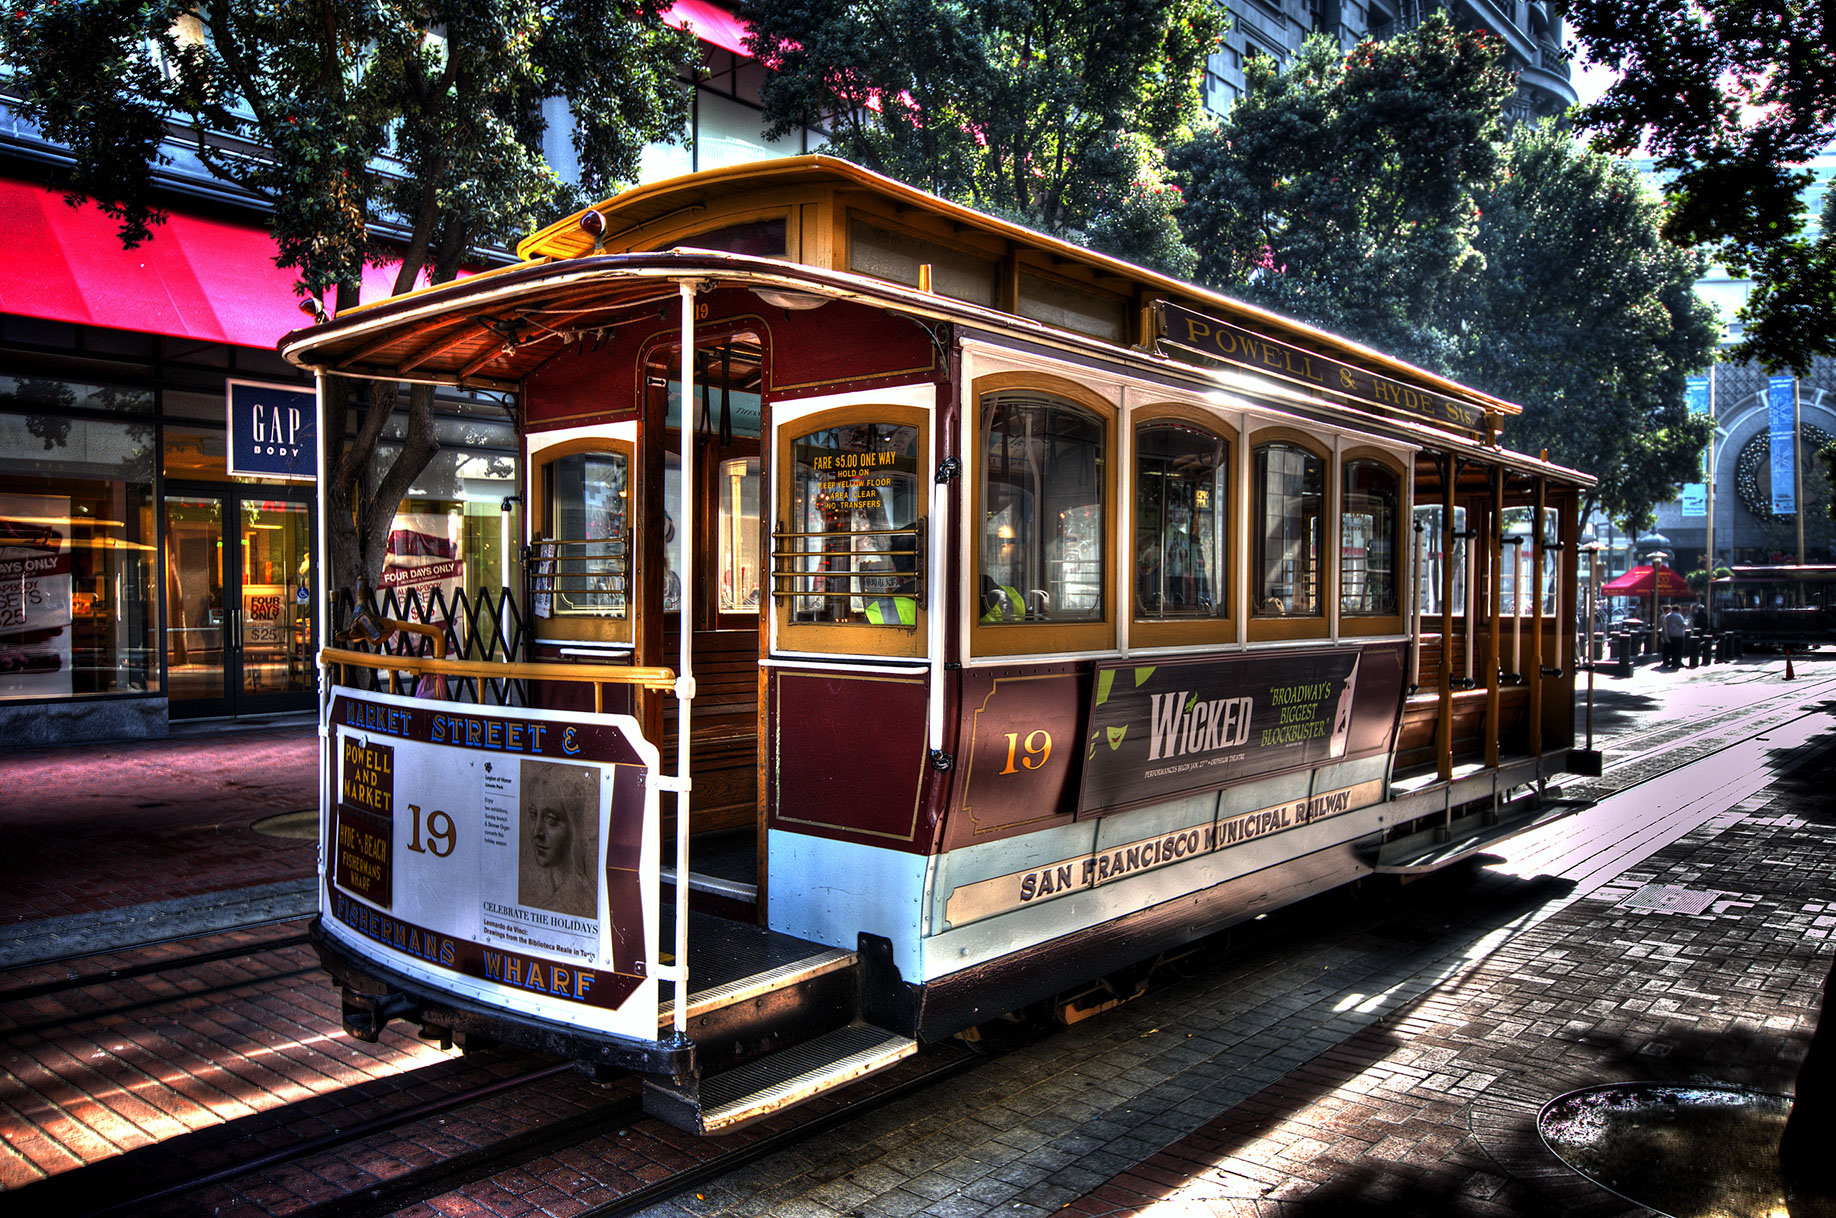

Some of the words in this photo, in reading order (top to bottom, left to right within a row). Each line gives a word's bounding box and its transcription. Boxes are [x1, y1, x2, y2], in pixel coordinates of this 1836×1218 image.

[695, 303, 709, 320] 19
[1185, 317, 1323, 382] POWELL
[1339, 367, 1358, 390] &
[1373, 378, 1435, 414] HYDE
[1446, 402, 1476, 426] Sts.
[252, 403, 301, 445] GAP
[253, 445, 299, 457] BODY
[813, 456, 833, 470] FARE
[835, 453, 858, 468] $5.00
[860, 452, 876, 467] ONE
[878, 451, 896, 465] WAY
[837, 469, 857, 478] HOLD
[859, 468, 870, 476] ON
[818, 481, 836, 489] KEEP
[837, 480, 865, 489] YELLOW
[866, 478, 892, 487] FLOOR
[830, 491, 849, 499] AREA
[852, 490, 876, 498] CLEAR
[840, 500, 881, 509] TRANSFERS
[25, 557, 58, 571] ONLY
[384, 571, 409, 583] FOUR
[410, 567, 432, 578] DAYS
[433, 563, 455, 574] ONLY
[0, 608, 28, 627] 25
[251, 603, 281, 612] DAYS
[251, 611, 279, 620] ONLY
[251, 629, 277, 641] $25
[1280, 702, 1319, 724] BIGGEST
[346, 700, 412, 736] MARKET
[431, 714, 547, 752] STREET
[562, 726, 581, 755] &
[345, 743, 391, 774] POWELL
[998, 729, 1053, 776] 19
[355, 768, 378, 786] AND
[1144, 765, 1178, 779] PERFORMANCES
[344, 778, 392, 811] MARKET
[407, 803, 457, 858] 19
[340, 823, 355, 850] HYDE
[364, 833, 387, 863] BEACH
[1020, 863, 1072, 902] SAN
[1081, 829, 1199, 886] FRANCISCO
[1204, 811, 1290, 852] MUNICIPAL
[1295, 790, 1352, 823] RAILWAY
[342, 851, 381, 882] FISHERMANS
[350, 870, 371, 892] WHARF
[483, 901, 530, 921] CELEBRATE
[530, 911, 549, 925] THE
[550, 916, 599, 935] HOLIDAYS
[483, 918, 506, 930] Leonardo
[506, 923, 513, 932] da
[513, 925, 528, 936] Vinci:
[337, 894, 456, 967] FISHERMANS
[483, 950, 596, 1000] WHARF
[483, 926, 505, 939] Drawings
[506, 932, 518, 942] from
[518, 935, 527, 944] the
[528, 938, 555, 950] Biblioteca
[556, 944, 572, 955] Reale
[573, 946, 580, 956] in
